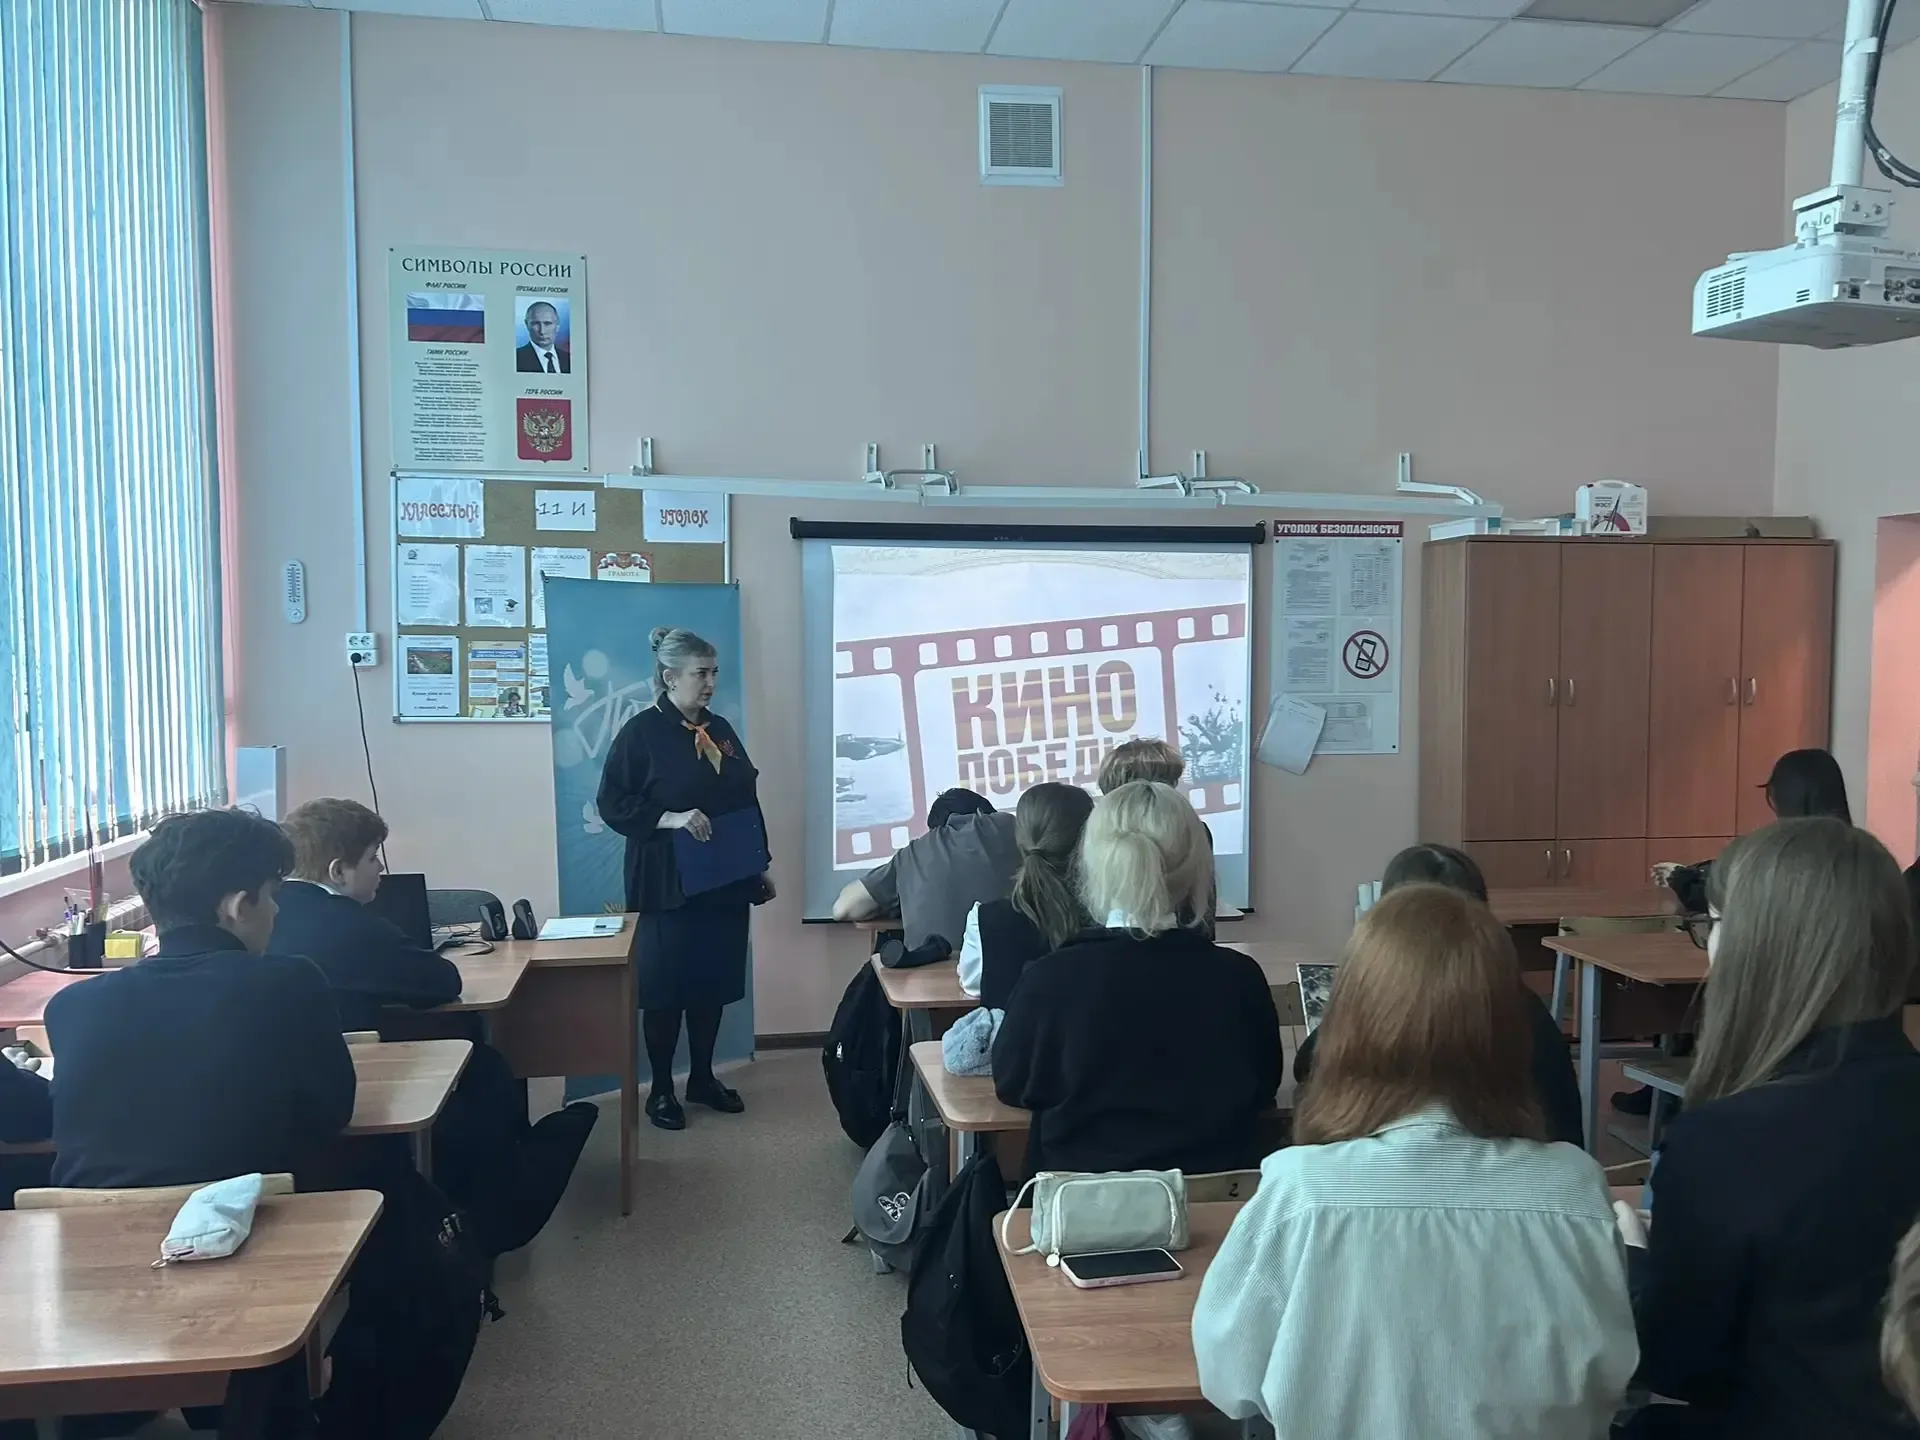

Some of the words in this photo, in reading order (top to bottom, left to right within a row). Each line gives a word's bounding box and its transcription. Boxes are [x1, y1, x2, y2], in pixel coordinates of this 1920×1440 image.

[402, 257, 493, 275] СИМВОЛЫ
[500, 261, 572, 278] РОССИИ
[539, 502, 563, 515] 11
[572, 502, 586, 515] И
[1277, 524, 1318, 534] УГОЛОК
[1320, 524, 1399, 535] БЕЗОПАСНОСТИ
[951, 660, 1137, 751] КИНО
